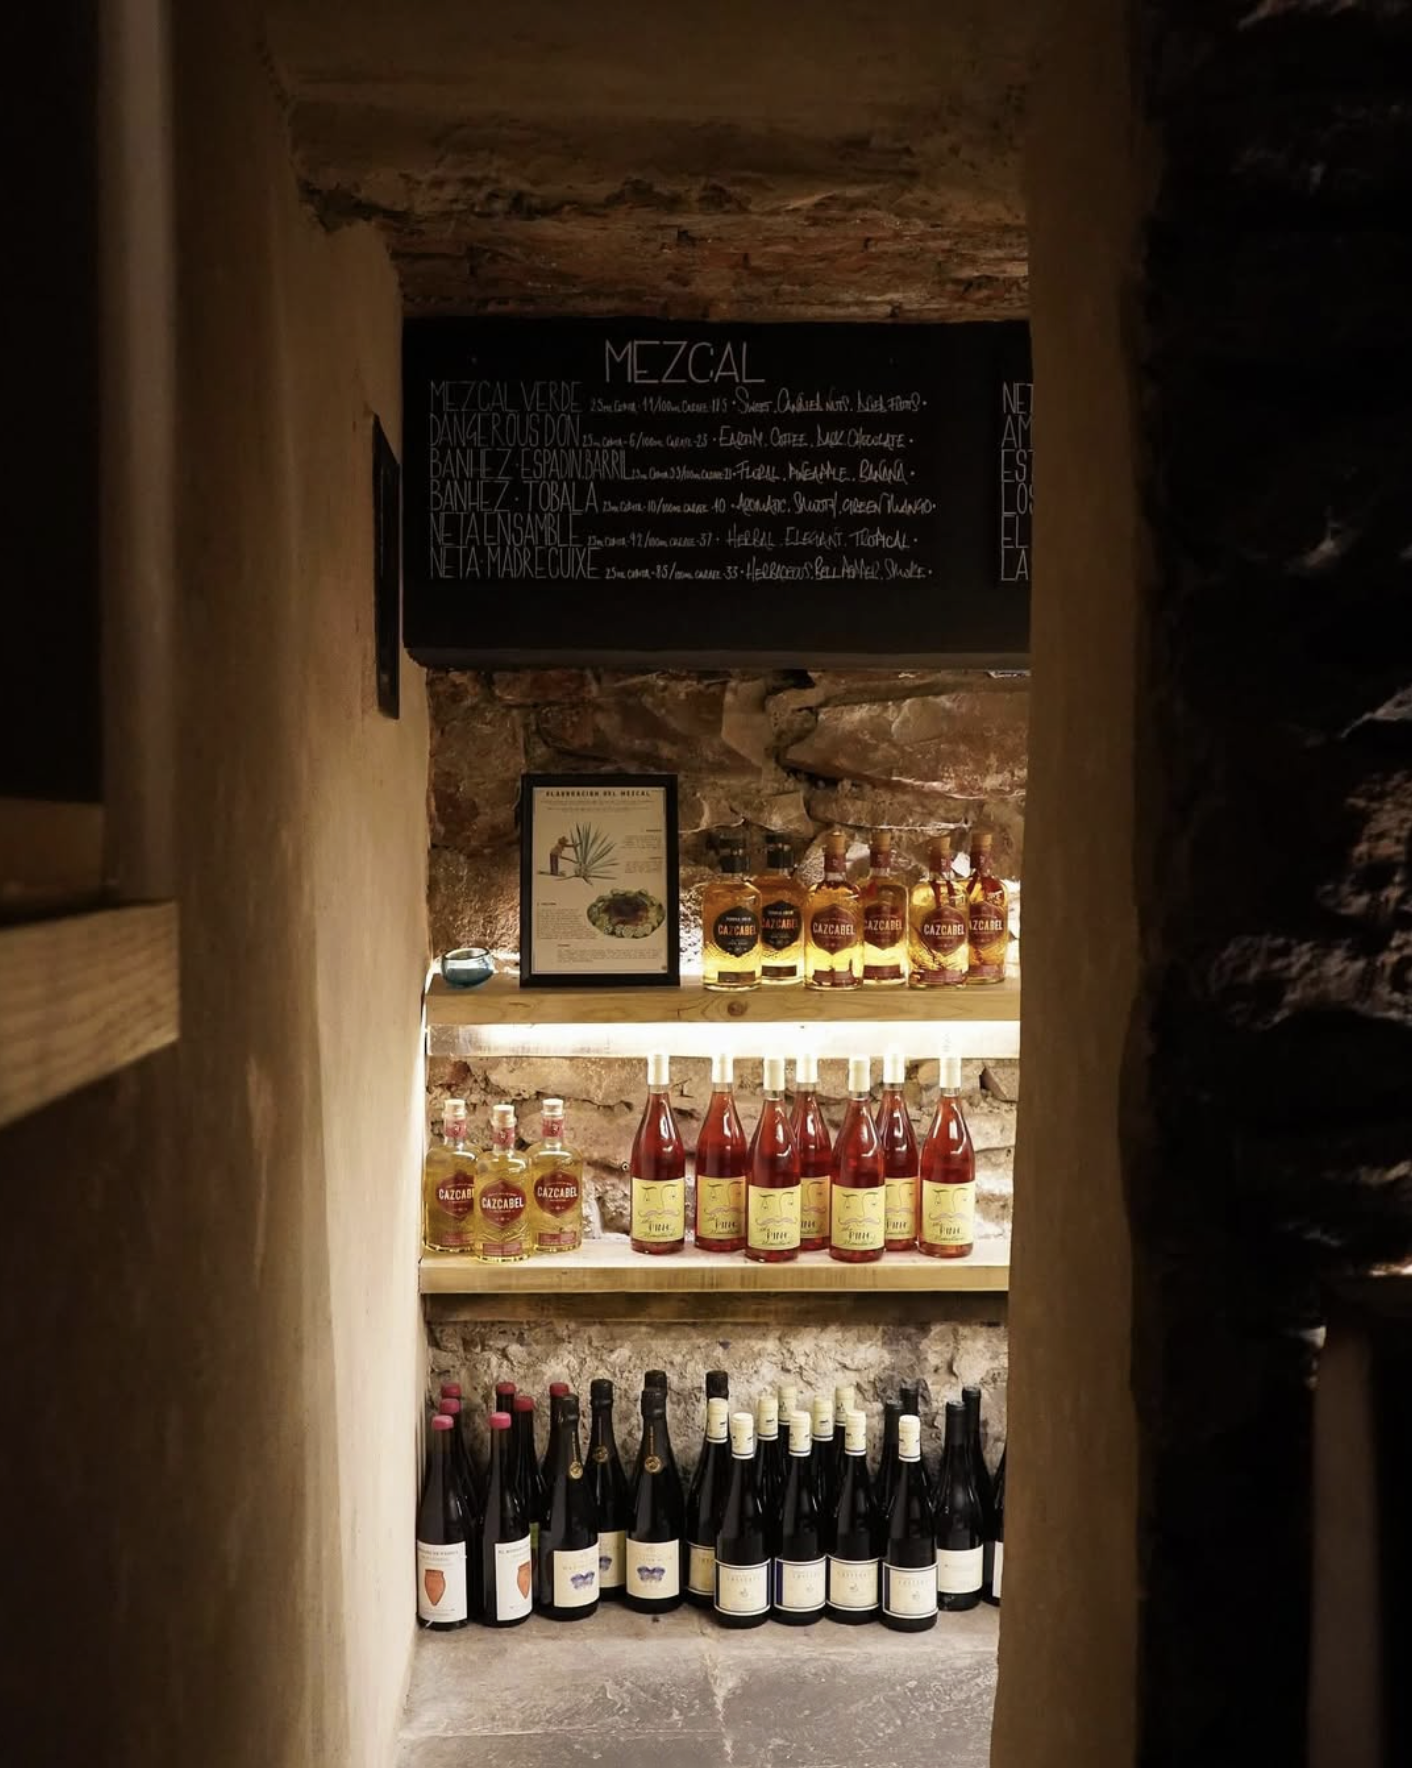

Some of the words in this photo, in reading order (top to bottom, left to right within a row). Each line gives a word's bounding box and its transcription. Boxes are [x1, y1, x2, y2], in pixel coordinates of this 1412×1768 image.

[605, 338, 765, 383] MEZCAL
[430, 380, 520, 412] MEZCAL
[520, 380, 583, 412] VERDE
[429, 412, 540, 448] DANGEROUS
[544, 412, 580, 448] DON
[430, 448, 513, 480] BANHEZ
[430, 480, 511, 512] BANHEZ
[522, 480, 598, 513] TOBALA
[430, 511, 480, 546] NETA
[483, 511, 583, 548] ENSAMBLE
[430, 546, 480, 580] NETA
[717, 923, 757, 936] CAZCABEL
[812, 922, 856, 936] CAZCABEL
[923, 923, 965, 936] CAZCABEL
[968, 919, 1004, 931] AZCABEL
[481, 1196, 525, 1210] CAZCABEL
[537, 1186, 579, 1198] CAZCABEL
